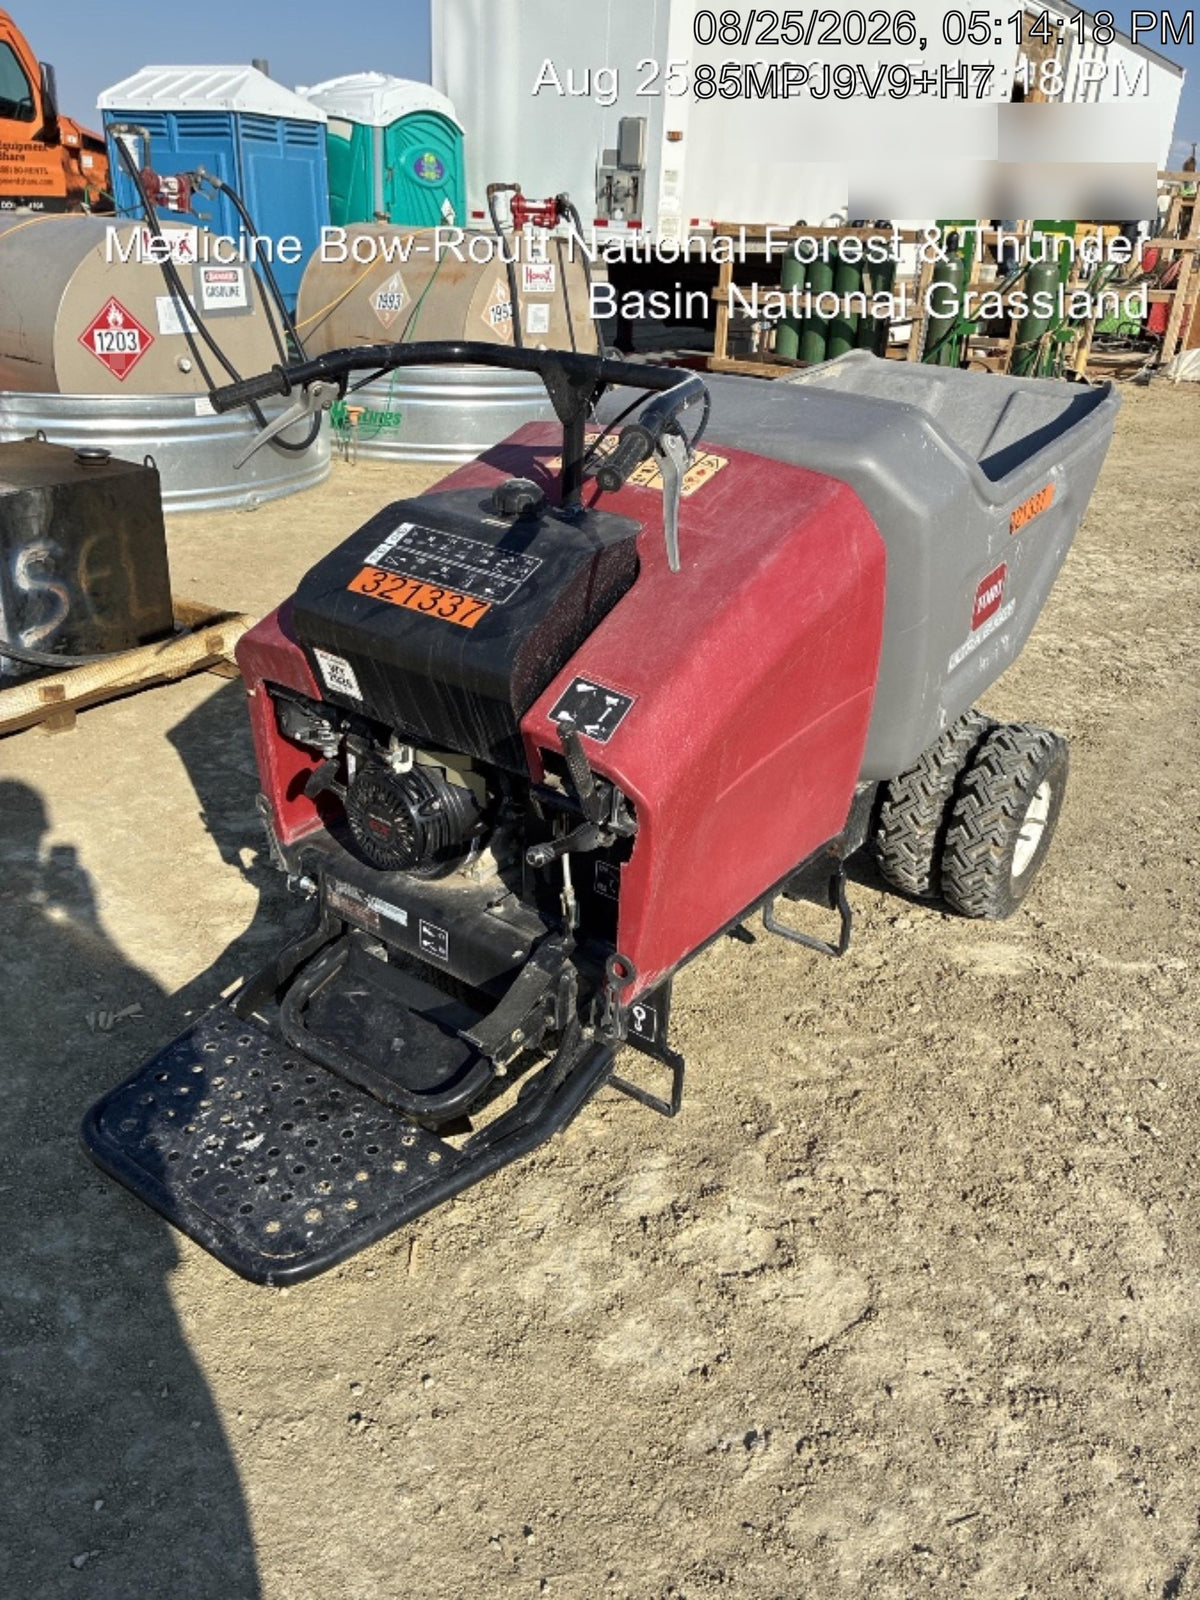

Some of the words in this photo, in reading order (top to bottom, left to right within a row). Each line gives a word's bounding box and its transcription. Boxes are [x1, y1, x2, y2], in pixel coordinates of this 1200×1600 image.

[206, 285, 240, 298] GASOLINE
[378, 294, 402, 310] 1993
[96, 331, 138, 352] 1203
[361, 571, 489, 623] 321337
